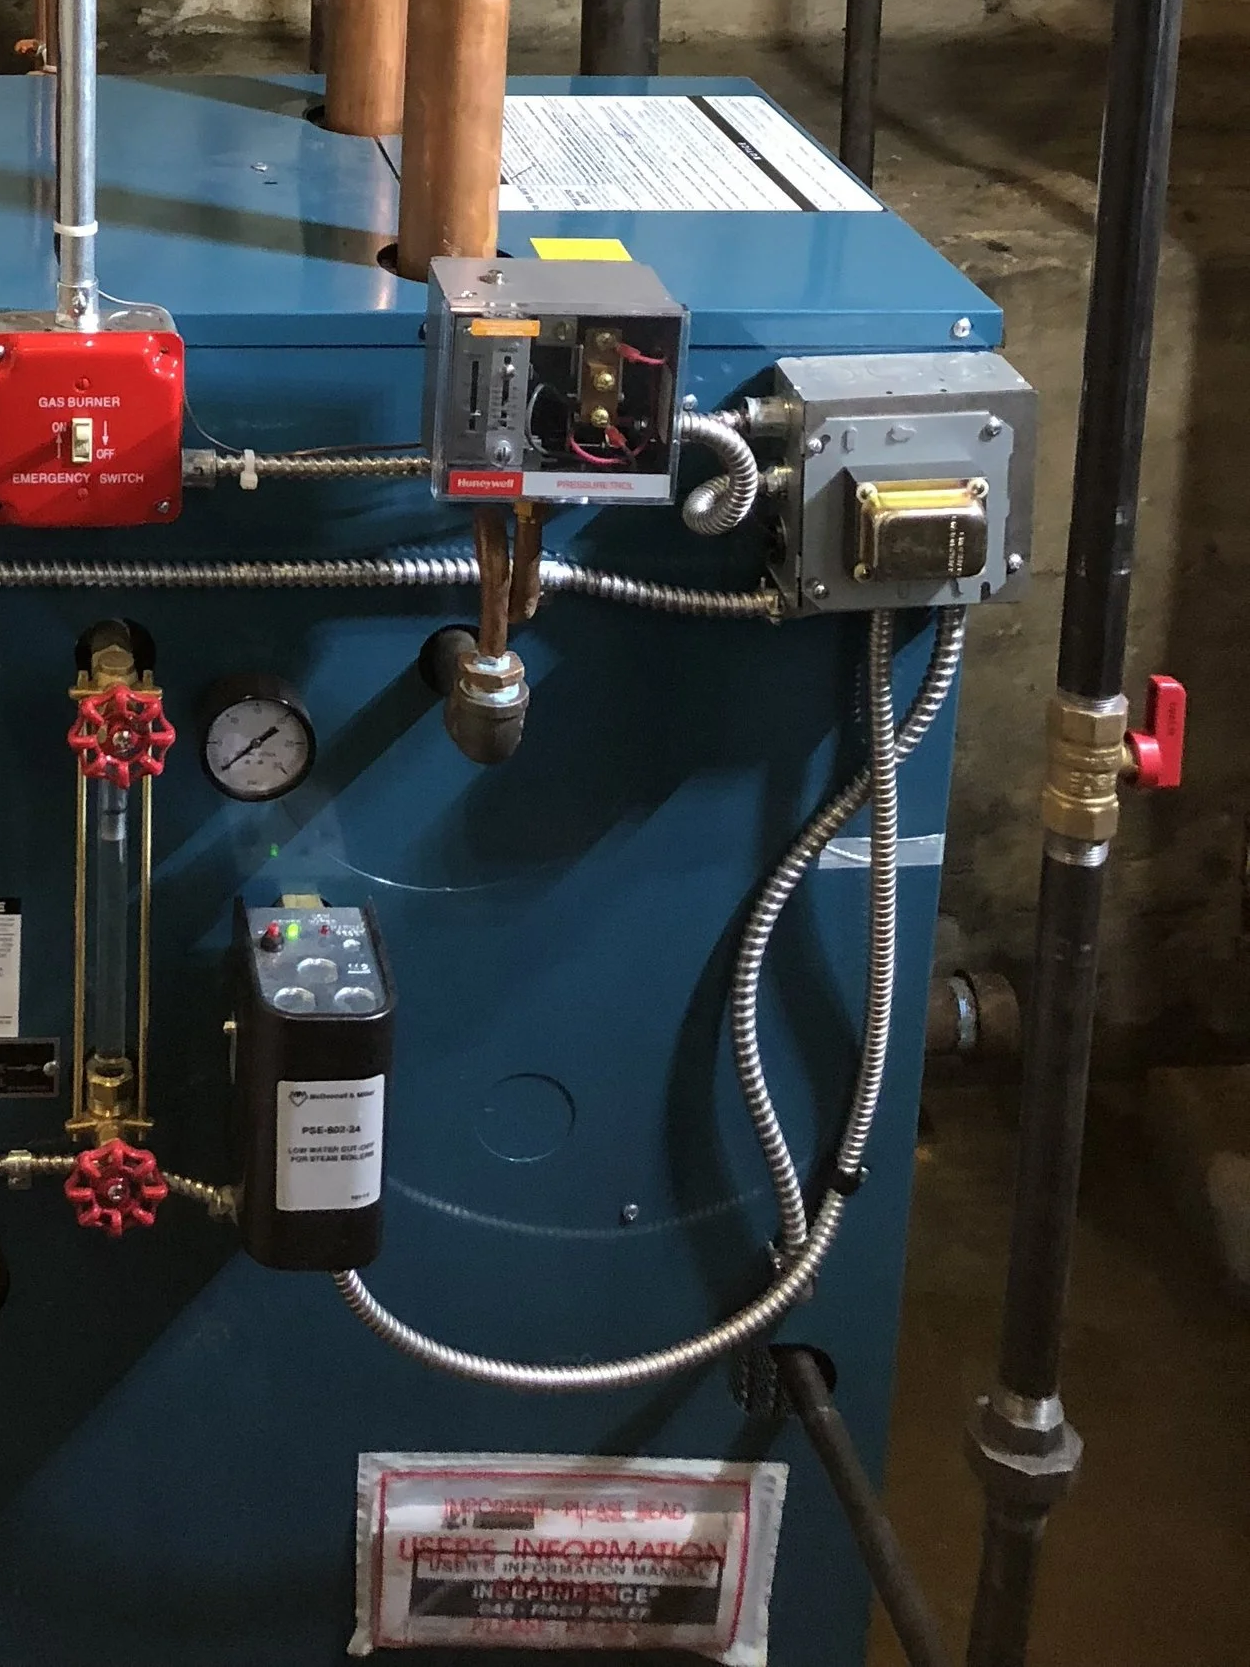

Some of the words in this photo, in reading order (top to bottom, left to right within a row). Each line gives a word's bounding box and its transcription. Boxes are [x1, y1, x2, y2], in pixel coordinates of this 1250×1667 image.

[38, 396, 65, 408] GAS
[68, 396, 121, 408] BURNER
[52, 421, 67, 434] ON
[96, 448, 115, 460] OFF
[12, 472, 91, 483] EMERGENCY
[99, 472, 144, 483] SWITCH
[457, 477, 514, 489] Honeywell
[289, 1146, 308, 1154] LOW
[309, 1154, 338, 1163] STEAM
